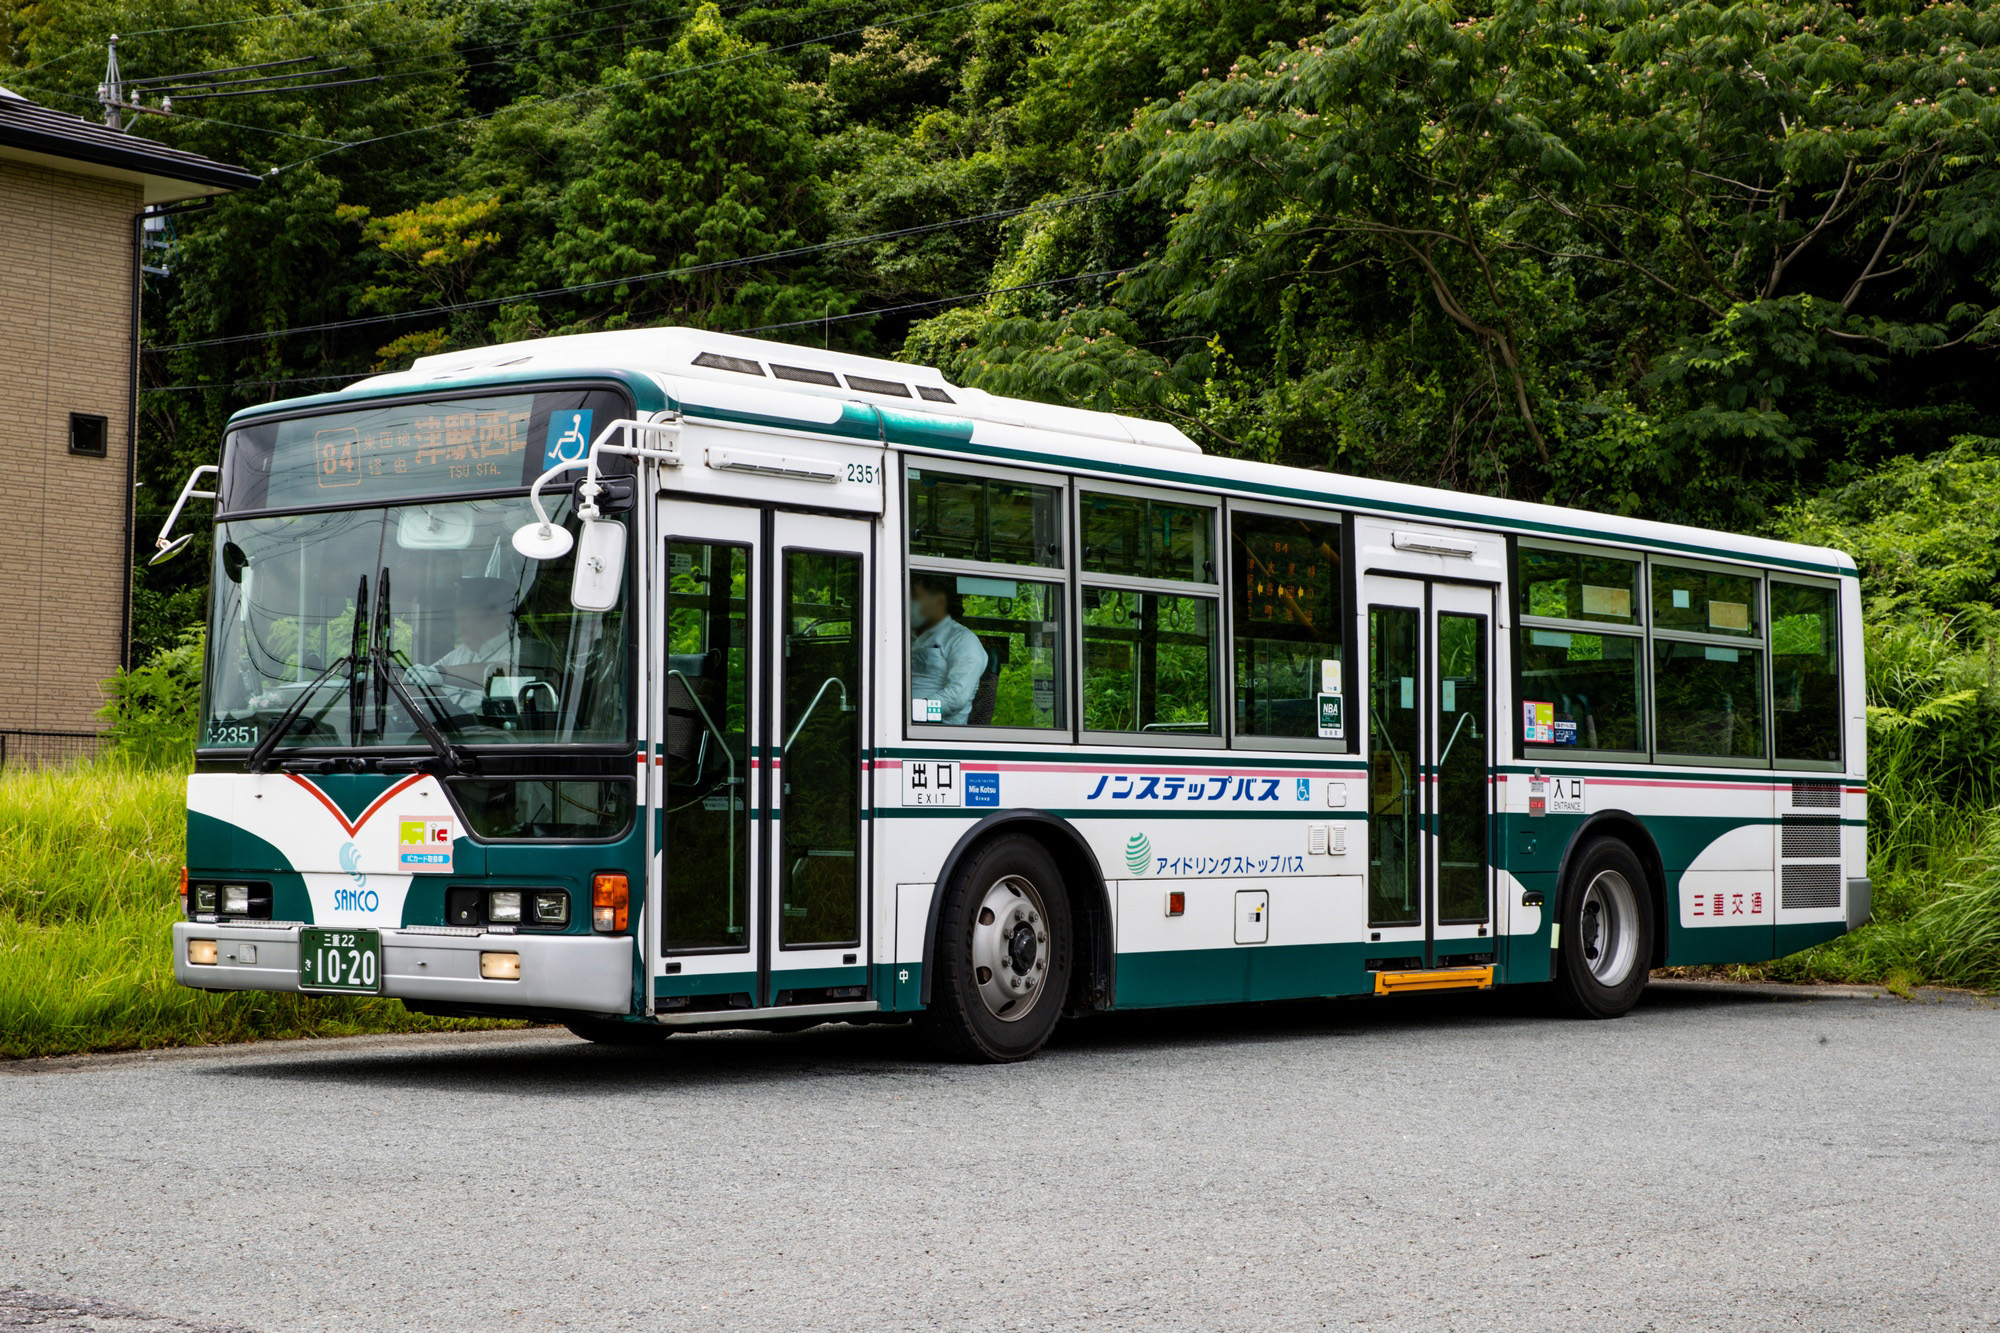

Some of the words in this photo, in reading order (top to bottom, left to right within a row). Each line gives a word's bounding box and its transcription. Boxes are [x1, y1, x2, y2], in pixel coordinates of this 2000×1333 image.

[449, 464, 470, 478] TSU
[847, 463, 880, 485] 2351
[1275, 541, 1289, 554] 84
[1323, 703, 1338, 714] NBA
[207, 726, 258, 744] C-2351
[912, 763, 952, 789] 出口
[968, 785, 979, 793] Mie
[980, 785, 996, 793] Kotsu
[1087, 775, 1280, 801] ノンステップバス
[1554, 779, 1581, 799] 入口
[917, 793, 946, 804] EXIT
[1554, 801, 1581, 811] ENTRANCE
[1156, 855, 1304, 875] アイドリングストップバス
[334, 889, 379, 912] SANCO
[1693, 892, 1762, 916] 三重交通
[899, 969, 908, 984] 中
